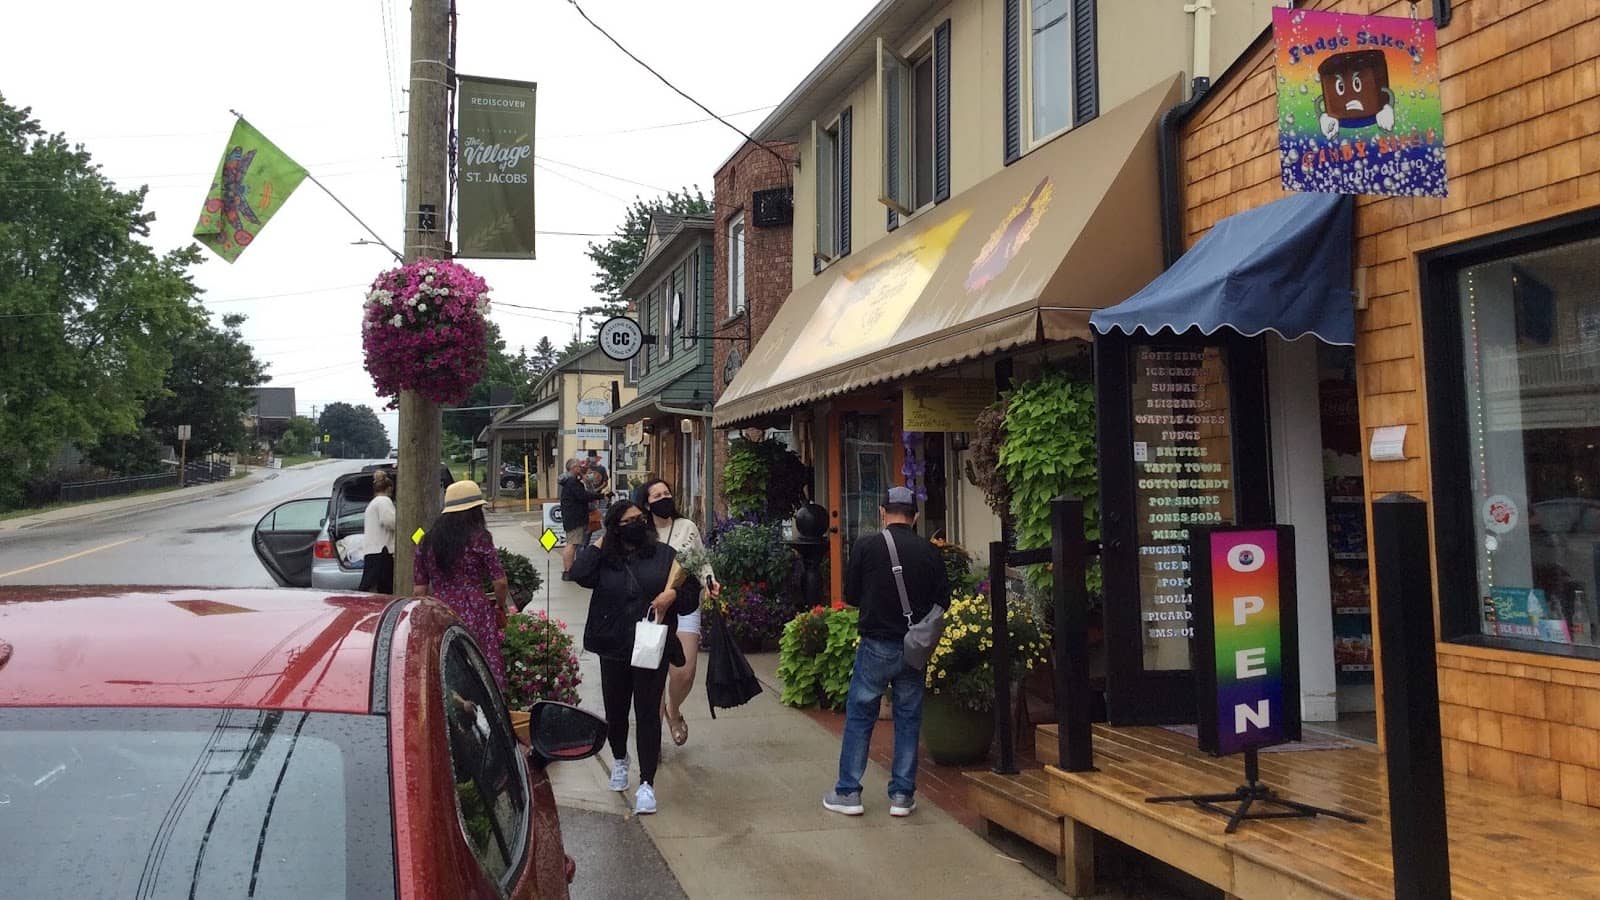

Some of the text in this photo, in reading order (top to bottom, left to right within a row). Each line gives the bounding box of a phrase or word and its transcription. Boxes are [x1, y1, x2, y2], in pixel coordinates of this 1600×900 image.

[471, 97, 526, 108] REDISCOVER
[464, 137, 481, 146] The
[464, 144, 531, 168] Village
[499, 160, 507, 172] of
[465, 172, 528, 184] ST. JACOBS
[612, 331, 630, 346] CC
[1146, 367, 1166, 376] ICE
[1151, 383, 1206, 392] SUNDAES
[1147, 399, 1212, 408] BLIZZARDS
[1135, 415, 1225, 424] WAFFLE CONES
[1161, 431, 1201, 441] FUDGE
[1156, 447, 1208, 457] BRITTLE
[1144, 463, 1222, 473] TAFFY TOWN
[1138, 479, 1229, 489] COTTON CANDY
[1149, 495, 1220, 507] POP SHOPPE
[1149, 512, 1222, 523] JONES SODA
[1141, 545, 1186, 555] PUCKER
[1158, 561, 1178, 571] ICE
[1159, 594, 1192, 604] LOLLI
[1149, 612, 1192, 621] PICARD
[1155, 628, 1177, 638] MS.
[1227, 543, 1270, 734] OPEN
